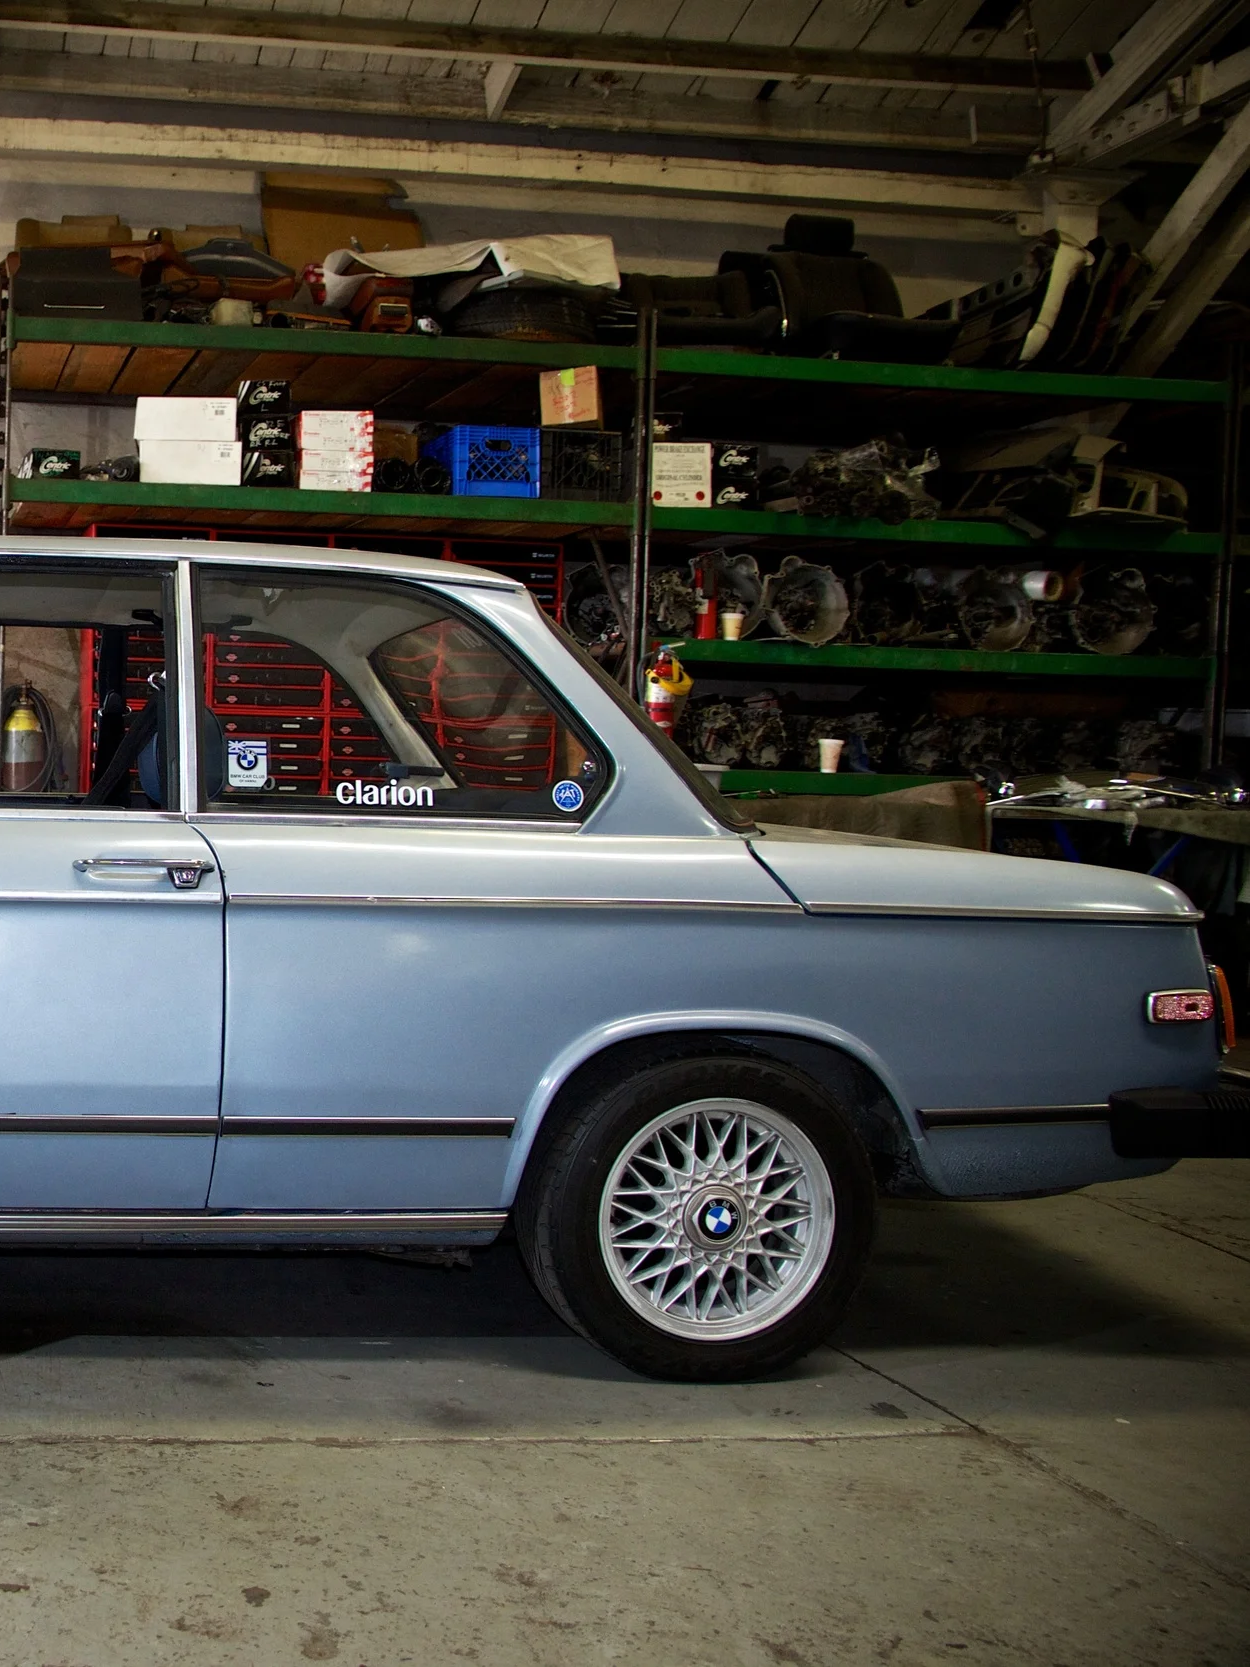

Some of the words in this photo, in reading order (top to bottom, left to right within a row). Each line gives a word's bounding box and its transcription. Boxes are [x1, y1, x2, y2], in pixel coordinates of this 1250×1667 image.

[39, 455, 72, 474] Centric
[716, 486, 749, 505] Centric
[336, 779, 434, 806] Clarion
[708, 1200, 739, 1220] BMW
